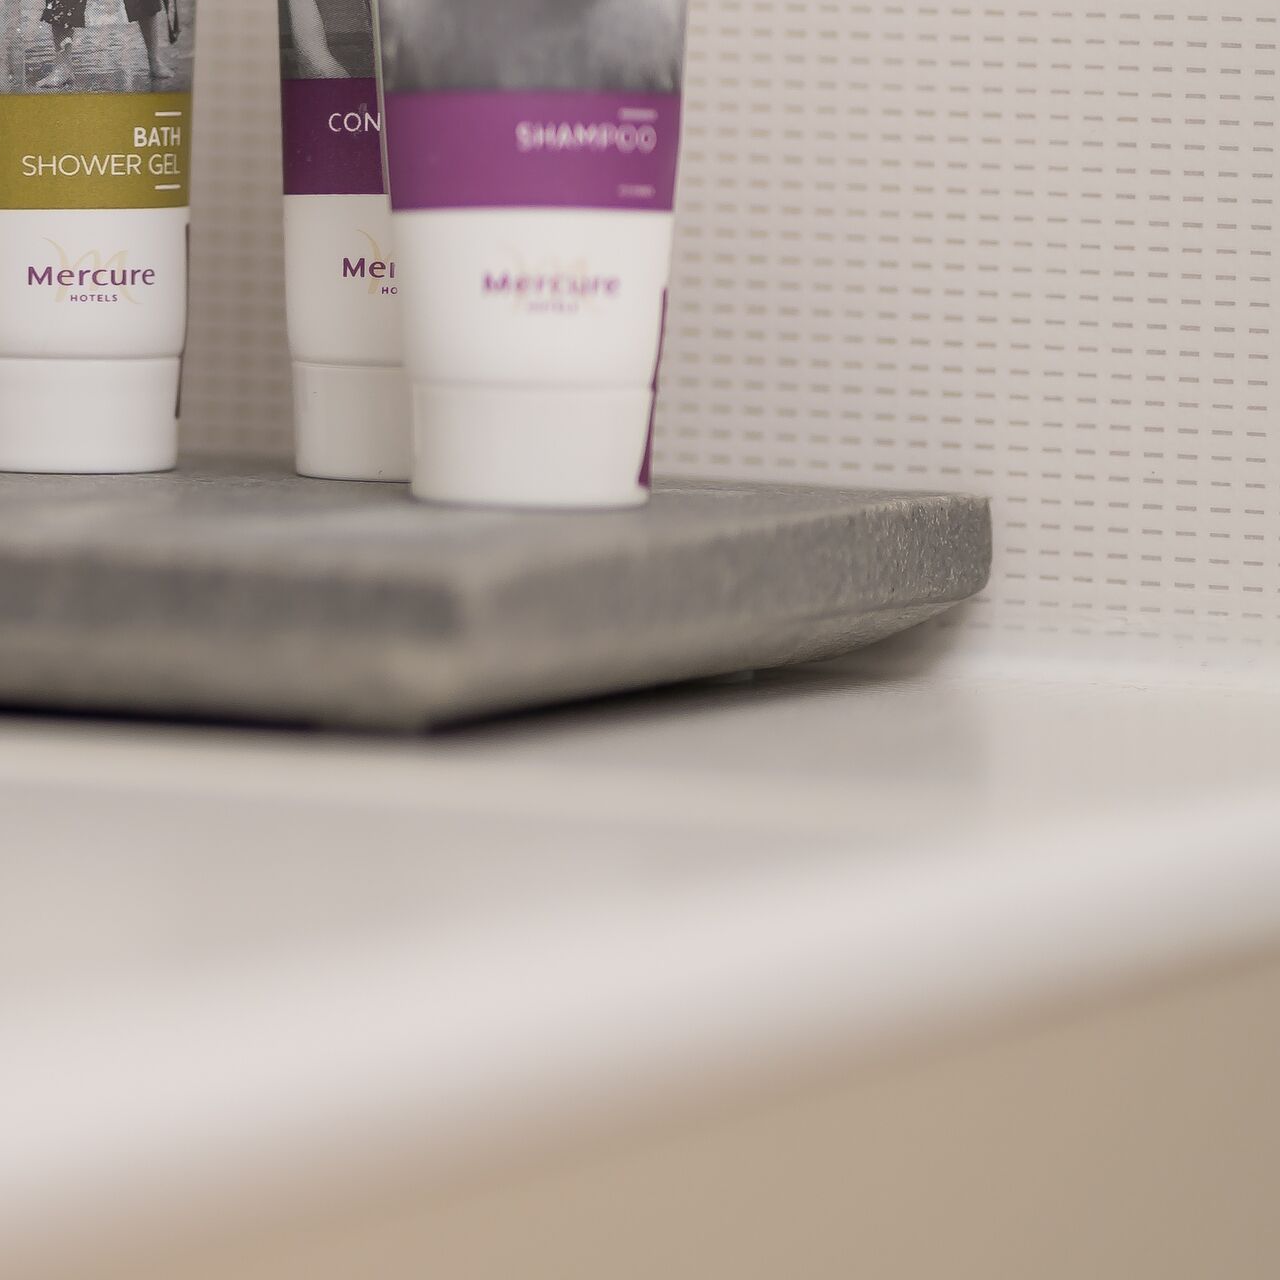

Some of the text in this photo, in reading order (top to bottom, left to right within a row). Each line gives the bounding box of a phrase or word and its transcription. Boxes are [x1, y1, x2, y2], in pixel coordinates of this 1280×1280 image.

[328, 112, 381, 132] CON
[133, 126, 181, 147] BATH
[514, 120, 657, 153] SHAMPOO
[22, 153, 181, 176] SHOWER GEL
[27, 266, 156, 286] Mercure
[481, 270, 622, 297] Mercure
[70, 294, 119, 303] HOTELS
